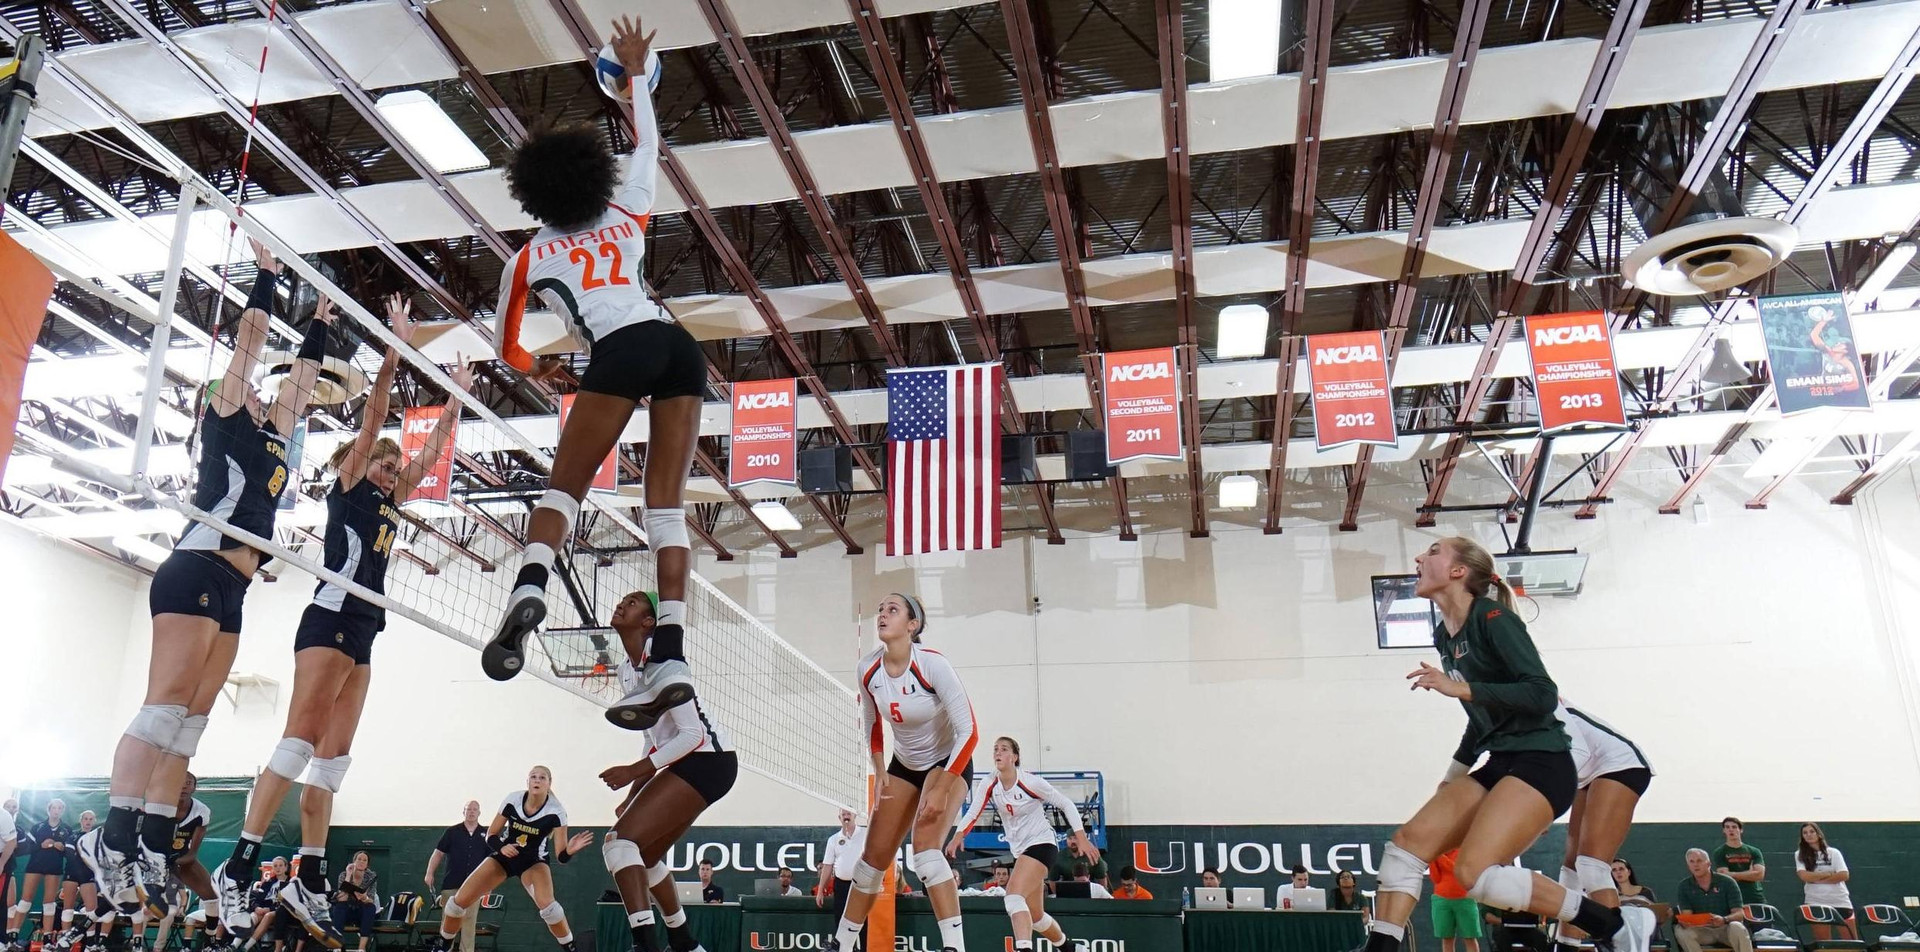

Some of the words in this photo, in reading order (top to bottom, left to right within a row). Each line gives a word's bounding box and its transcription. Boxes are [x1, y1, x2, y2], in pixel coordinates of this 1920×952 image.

[568, 242, 631, 291] 22
[1762, 301, 1784, 310] AVCA
[1784, 297, 1843, 307] ALL-AMERICAN
[1535, 324, 1602, 346] NCAA
[1315, 345, 1378, 365] NCAA
[1110, 362, 1169, 382] NCAA
[1545, 362, 1602, 373] VOLLEYBALL
[1537, 369, 1612, 381] CHAMPIONSHIPS
[1785, 375, 1824, 388] EMANI
[1825, 373, 1853, 384] SIMS
[1323, 382, 1376, 392] VOLLEYBALL
[737, 391, 790, 410] NCAA
[1316, 389, 1385, 400] CHAMPIONSHIPS
[1560, 393, 1603, 409] 2013
[1117, 398, 1165, 407] VOLLEYBALL
[1110, 407, 1143, 416] SECOND
[1143, 405, 1173, 414] ROUND
[1335, 412, 1375, 427] 2012
[741, 425, 784, 434] VOLLEYBALL
[1126, 428, 1161, 442] 2011
[734, 432, 792, 442] CHAMPIONSHIPS
[747, 454, 780, 467] 2010
[267, 464, 287, 498] 6
[372, 523, 396, 559] 14
[903, 684, 916, 695] U
[889, 702, 904, 723] 5
[1006, 803, 1014, 816] 9
[512, 821, 540, 835] SPARTANS
[515, 833, 528, 848] 4
[1133, 841, 1186, 874] U
[263, 870, 271, 880] G
